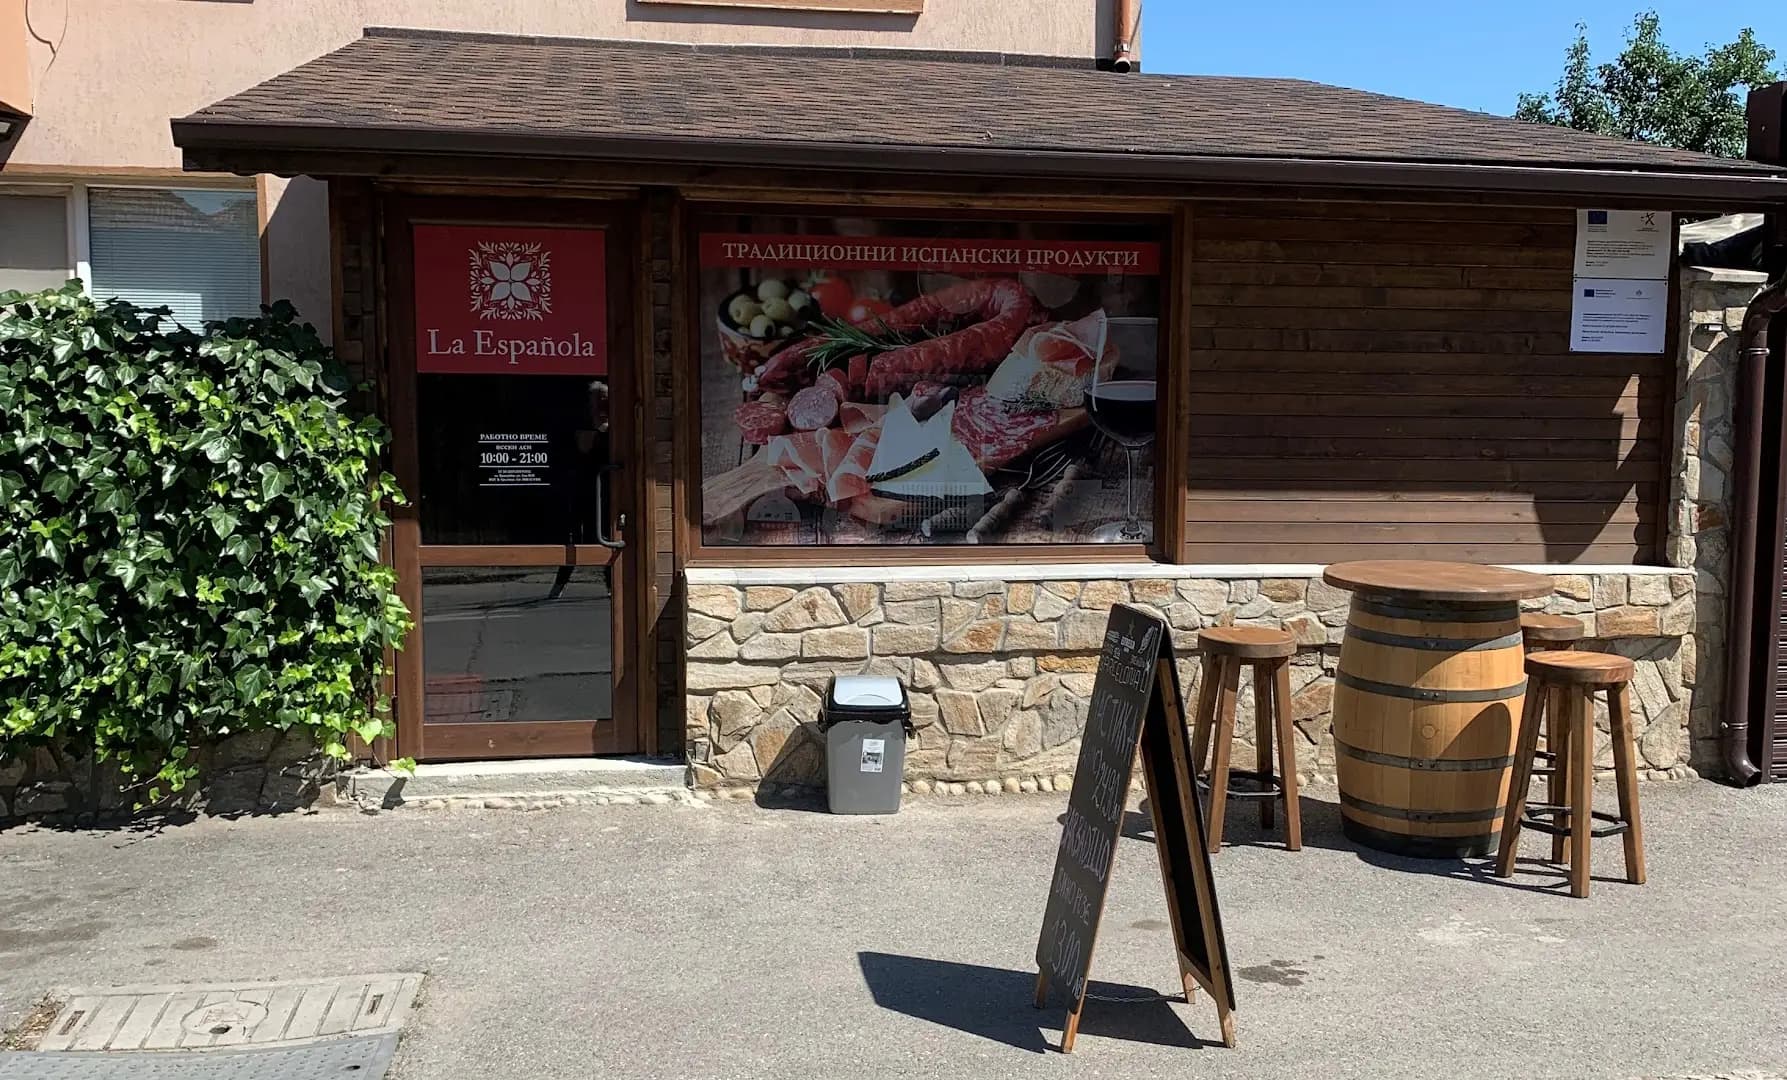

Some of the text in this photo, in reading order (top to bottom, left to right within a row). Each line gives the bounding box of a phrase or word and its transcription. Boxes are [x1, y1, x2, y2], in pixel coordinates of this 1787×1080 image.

[722, 242, 1140, 268] ТРАДИЦИОННИ ИСПАНСКИ ПРОДУКТИ
[427, 328, 596, 365] La Española
[480, 433, 548, 441] РАБОТНО ВРЕМЕ
[480, 452, 510, 464] 10:00
[519, 452, 548, 464] 21:00
